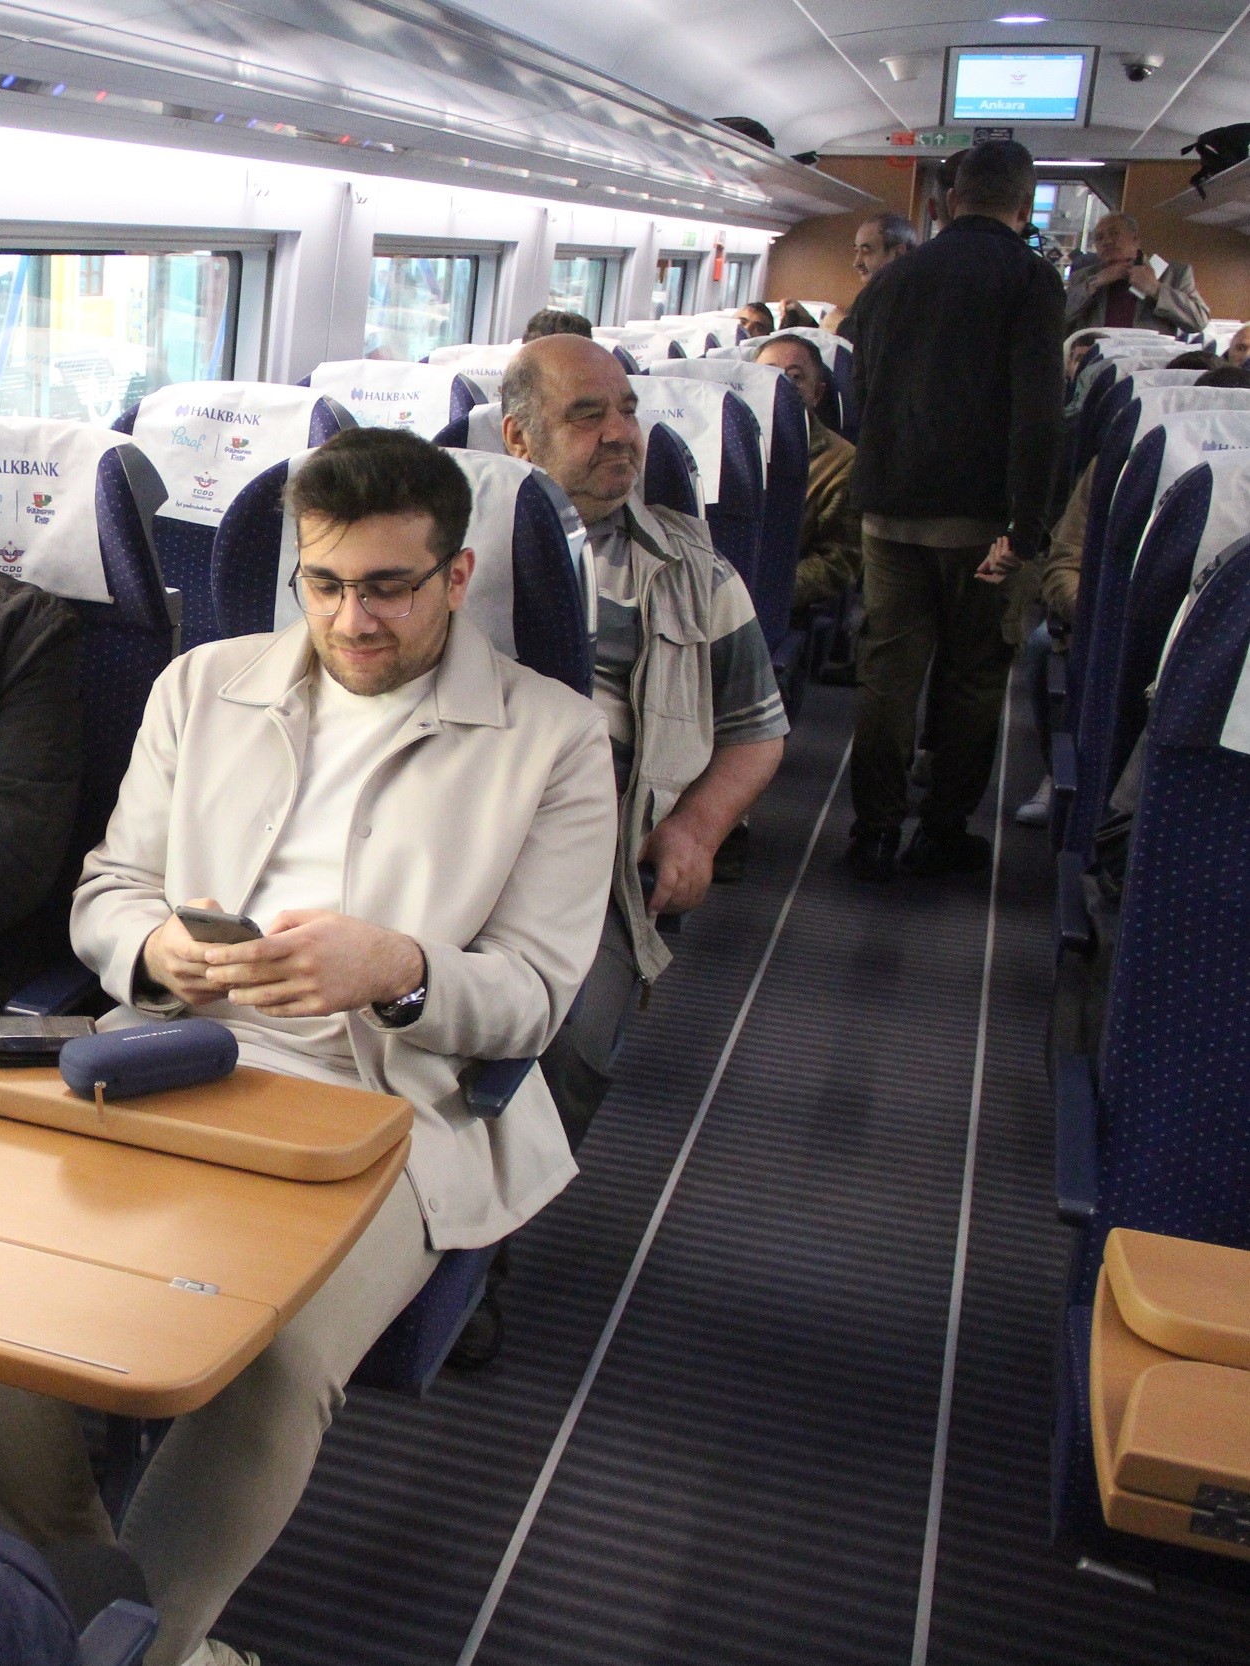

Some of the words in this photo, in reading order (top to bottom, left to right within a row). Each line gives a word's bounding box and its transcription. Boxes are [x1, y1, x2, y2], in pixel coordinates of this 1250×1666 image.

[978, 100, 1025, 110] Ankara
[466, 367, 503, 376] HALKBA
[364, 390, 420, 401] HALKBANK
[190, 406, 261, 426] HALKBANK
